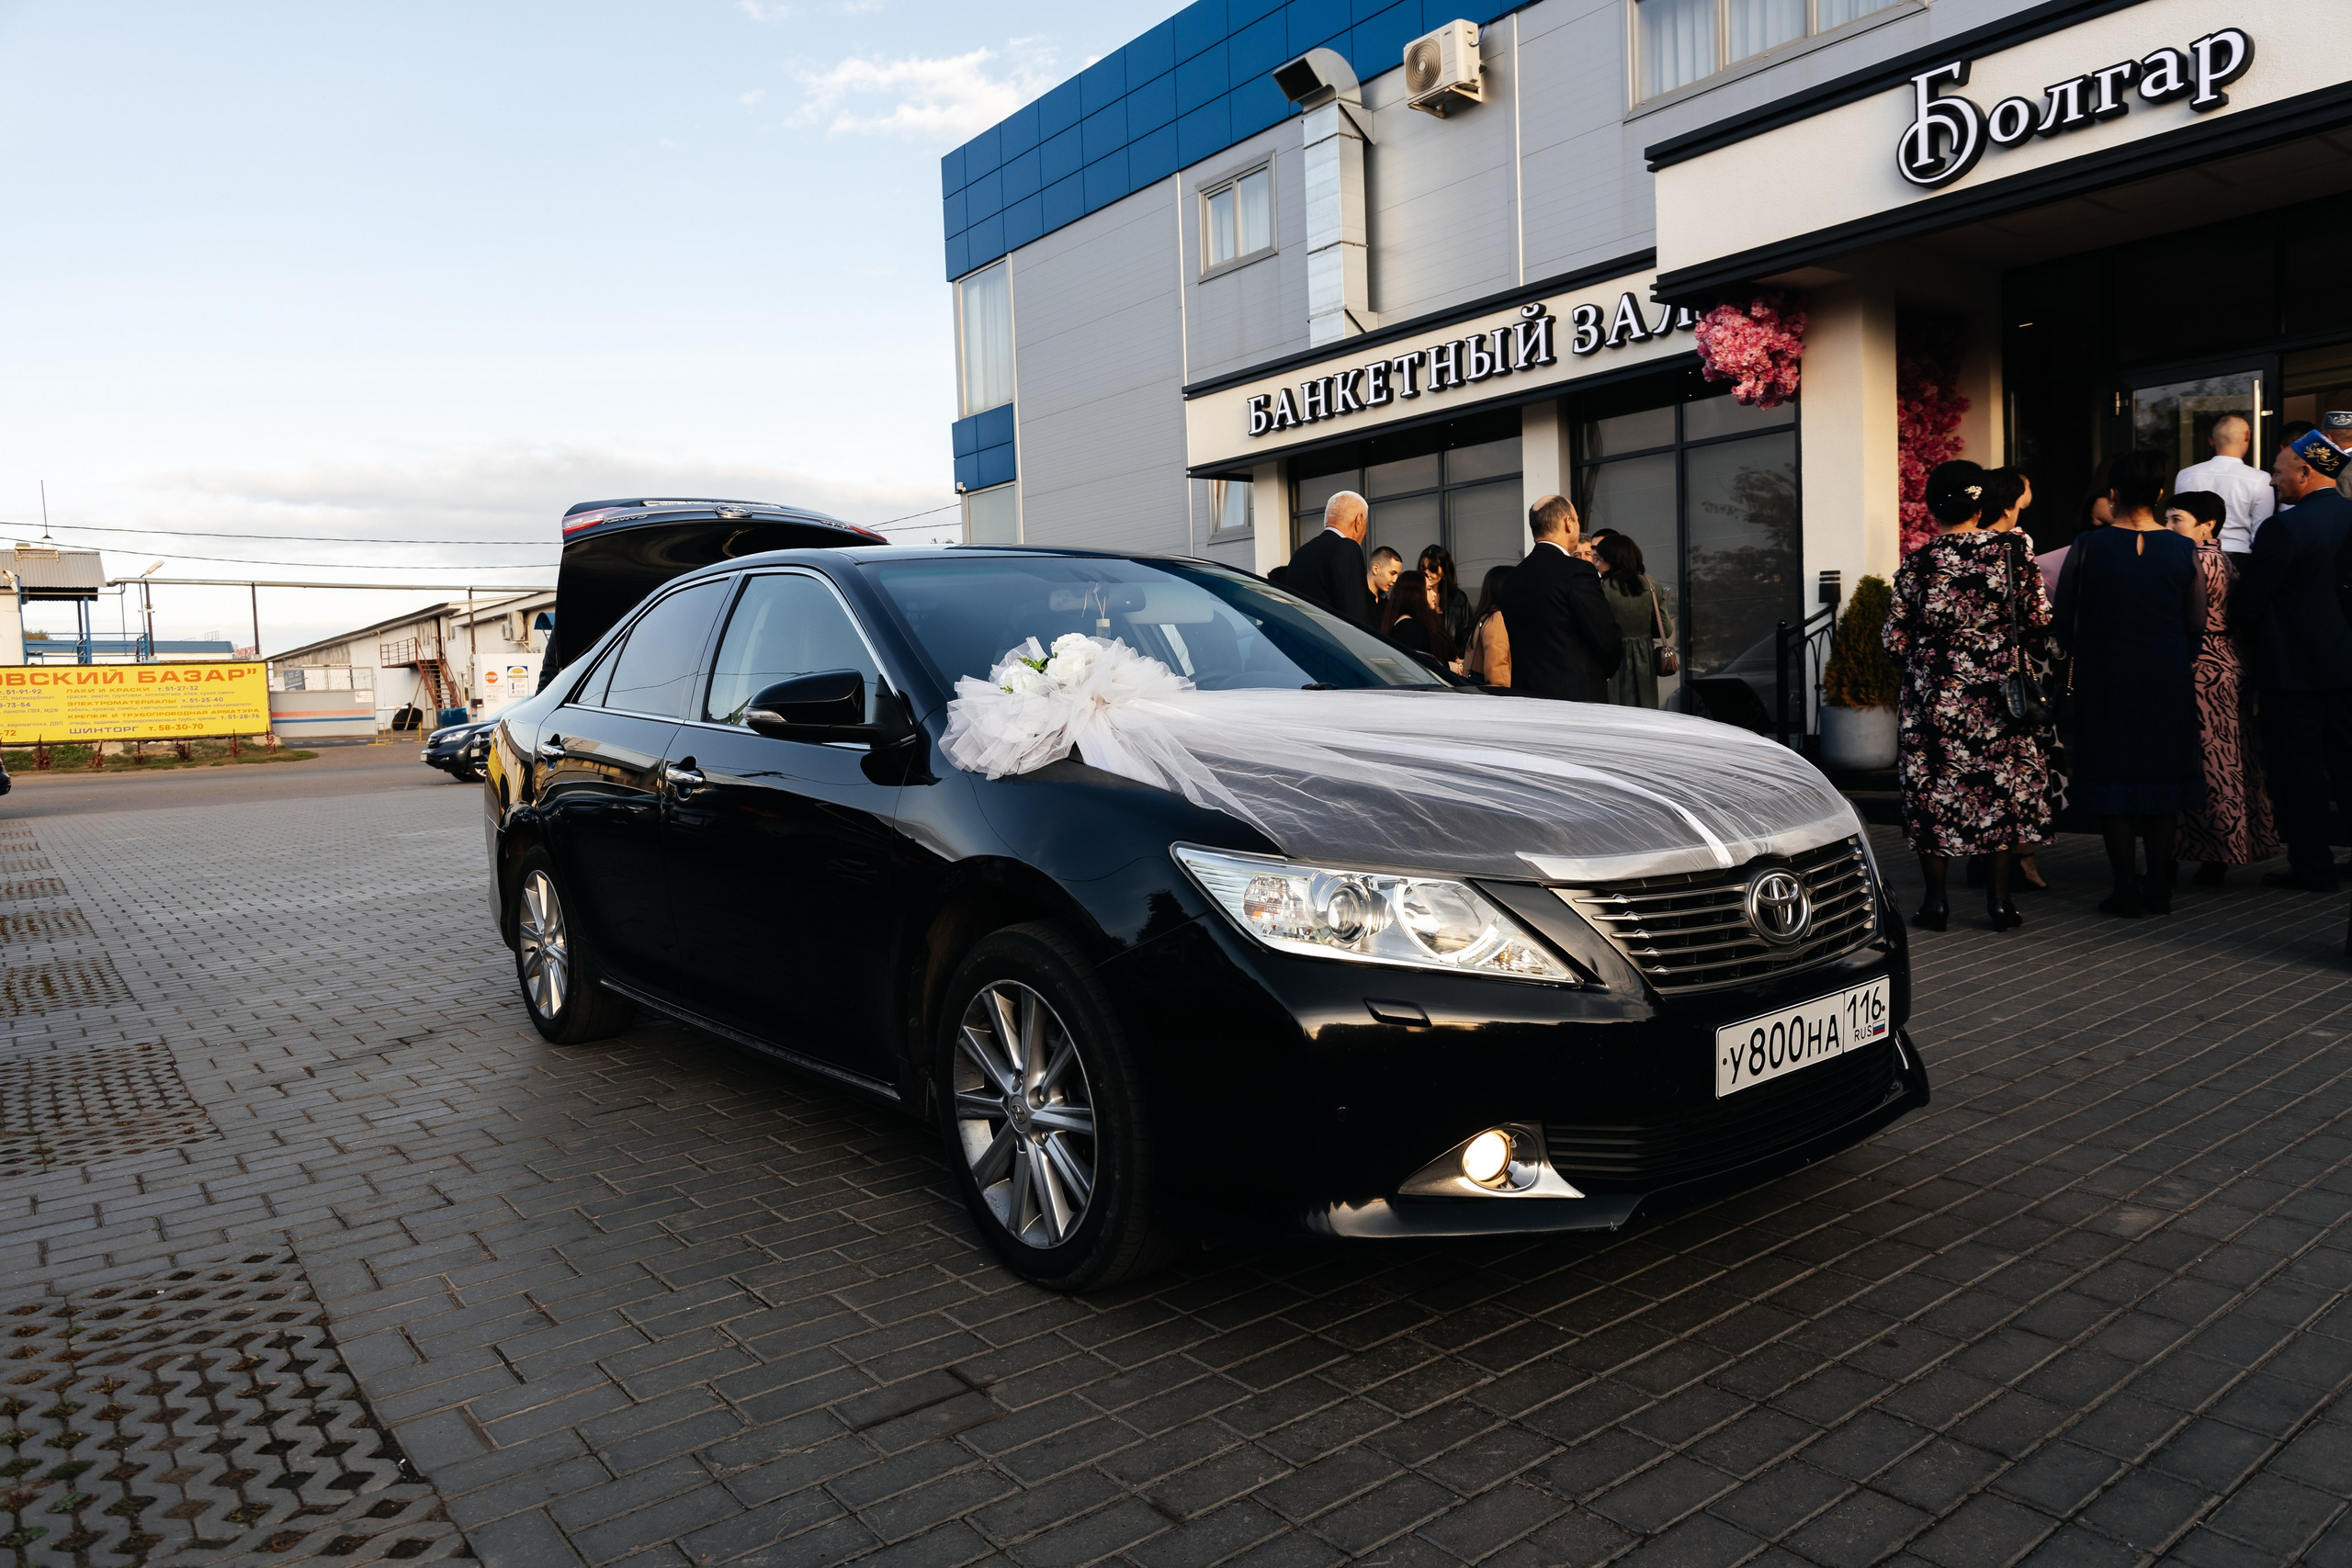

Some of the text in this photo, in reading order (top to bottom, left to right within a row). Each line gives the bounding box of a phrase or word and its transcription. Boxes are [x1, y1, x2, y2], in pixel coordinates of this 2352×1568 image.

[1896, 27, 2255, 188] Болгар
[1247, 302, 1557, 437] БАНКЕТНЫЙ
[0, 669, 124, 686] ВСКИЙ
[69, 726, 139, 735] ШИНТОРГ
[158, 723, 204, 731] 58-30-70
[1729, 986, 1883, 1085] У800НА 116
[1854, 1024, 1872, 1043] RUS
